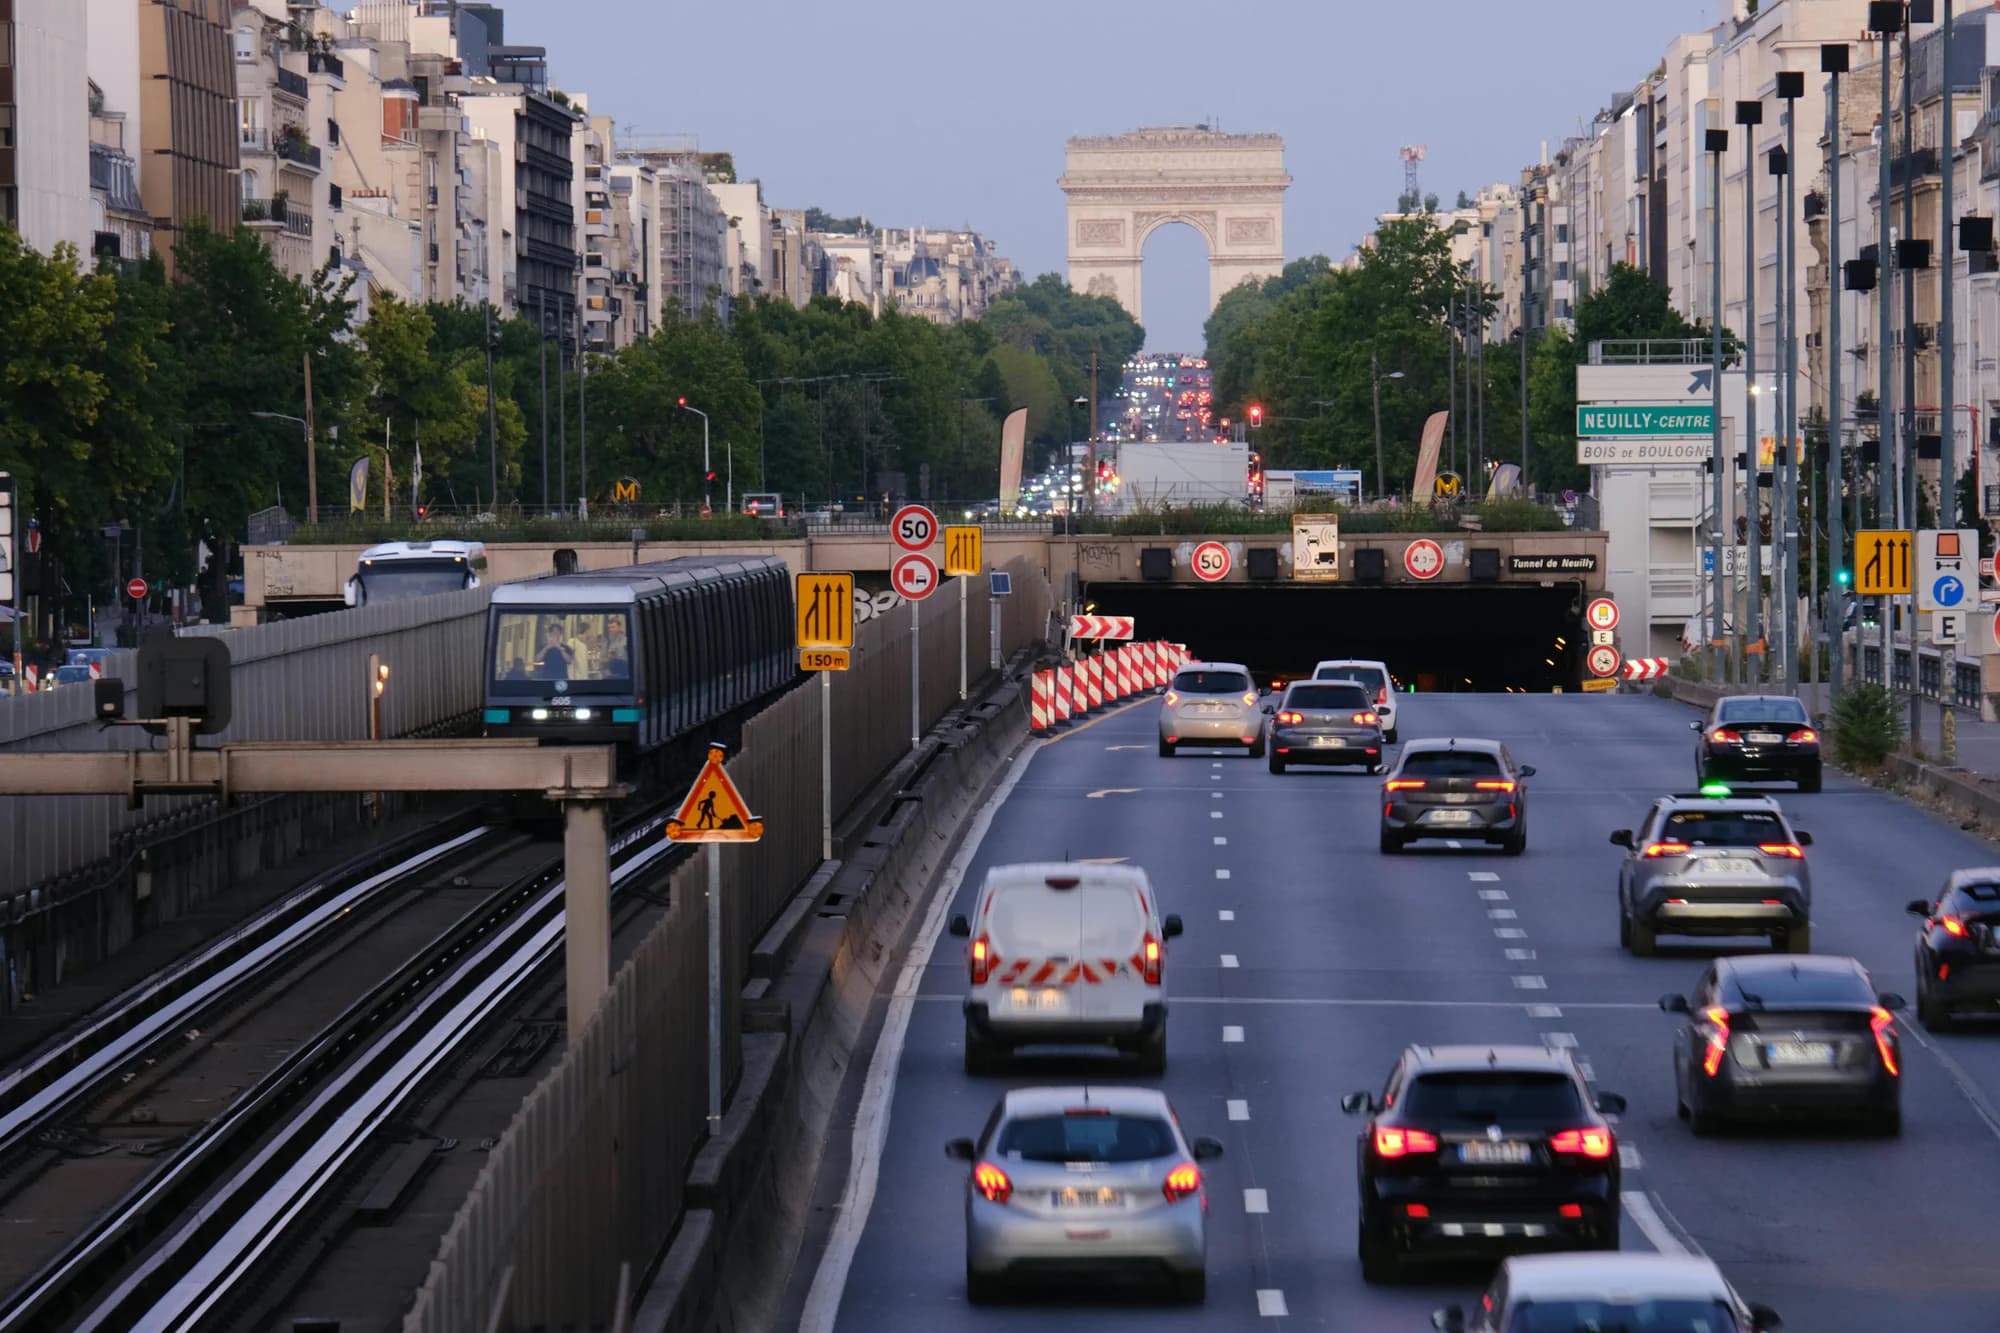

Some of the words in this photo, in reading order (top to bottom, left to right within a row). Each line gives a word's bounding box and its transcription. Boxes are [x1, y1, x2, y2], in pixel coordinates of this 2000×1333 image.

[1584, 413, 1711, 429] NEUILLY-CENTRE
[1584, 446, 1616, 458] BOIS
[1639, 445, 1712, 458] BOULOGNE
[615, 481, 636, 501] M
[1436, 477, 1457, 497] M
[901, 520, 928, 539] 50
[1200, 554, 1223, 569] 50
[1513, 559, 1544, 569] Tunnel
[1546, 559, 1558, 568] de
[1561, 558, 1594, 570] Neuilly
[1942, 616, 1956, 638] E
[1600, 632, 1607, 643] E
[806, 654, 832, 667] 150
[834, 657, 844, 667] m
